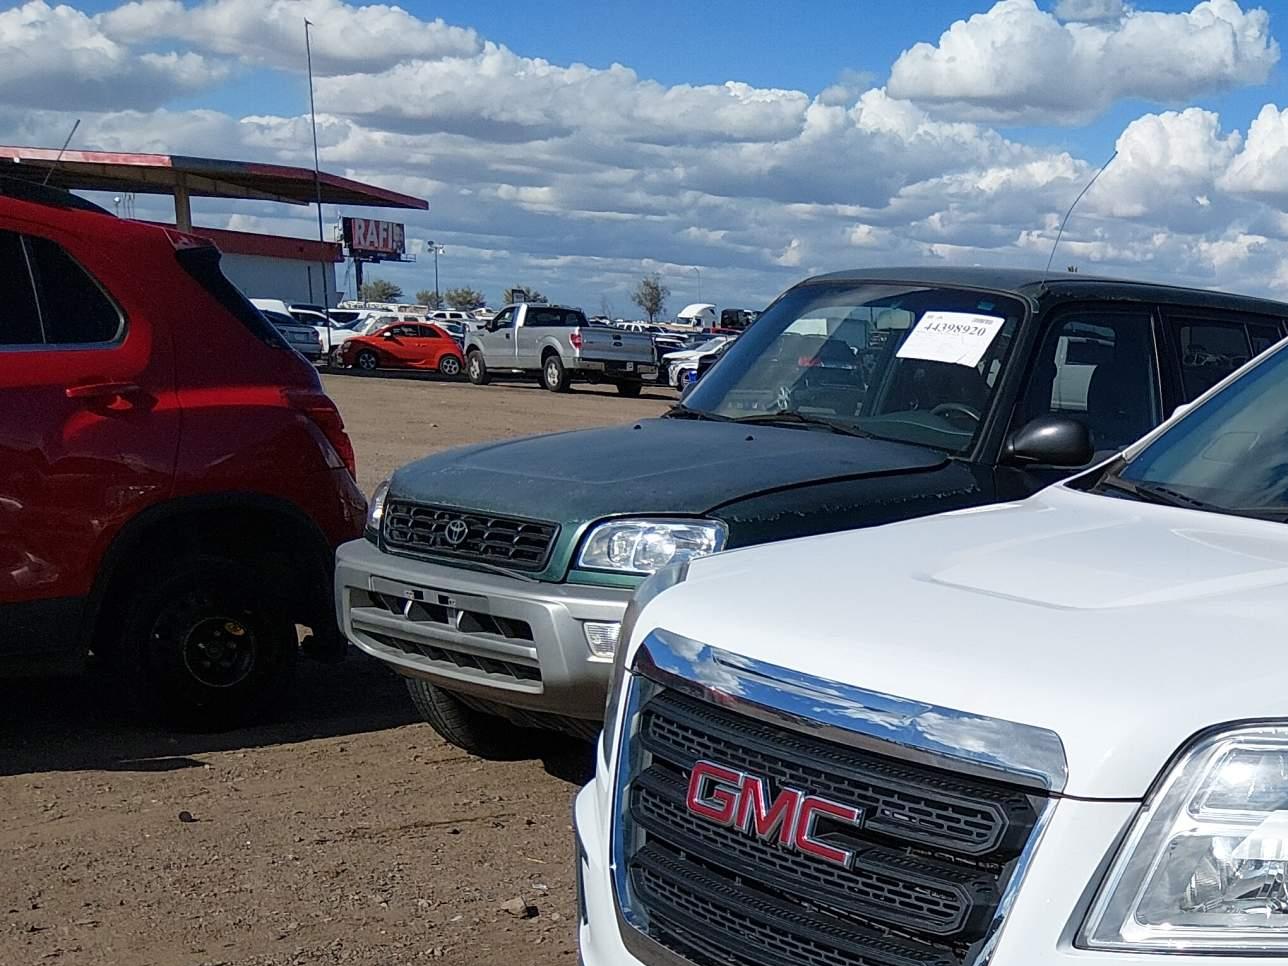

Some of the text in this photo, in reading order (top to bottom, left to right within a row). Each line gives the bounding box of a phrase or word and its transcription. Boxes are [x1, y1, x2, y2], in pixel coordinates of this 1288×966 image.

[354, 218, 394, 250] RAFI
[924, 322, 987, 337] 44398920
[687, 760, 865, 868] GMC
